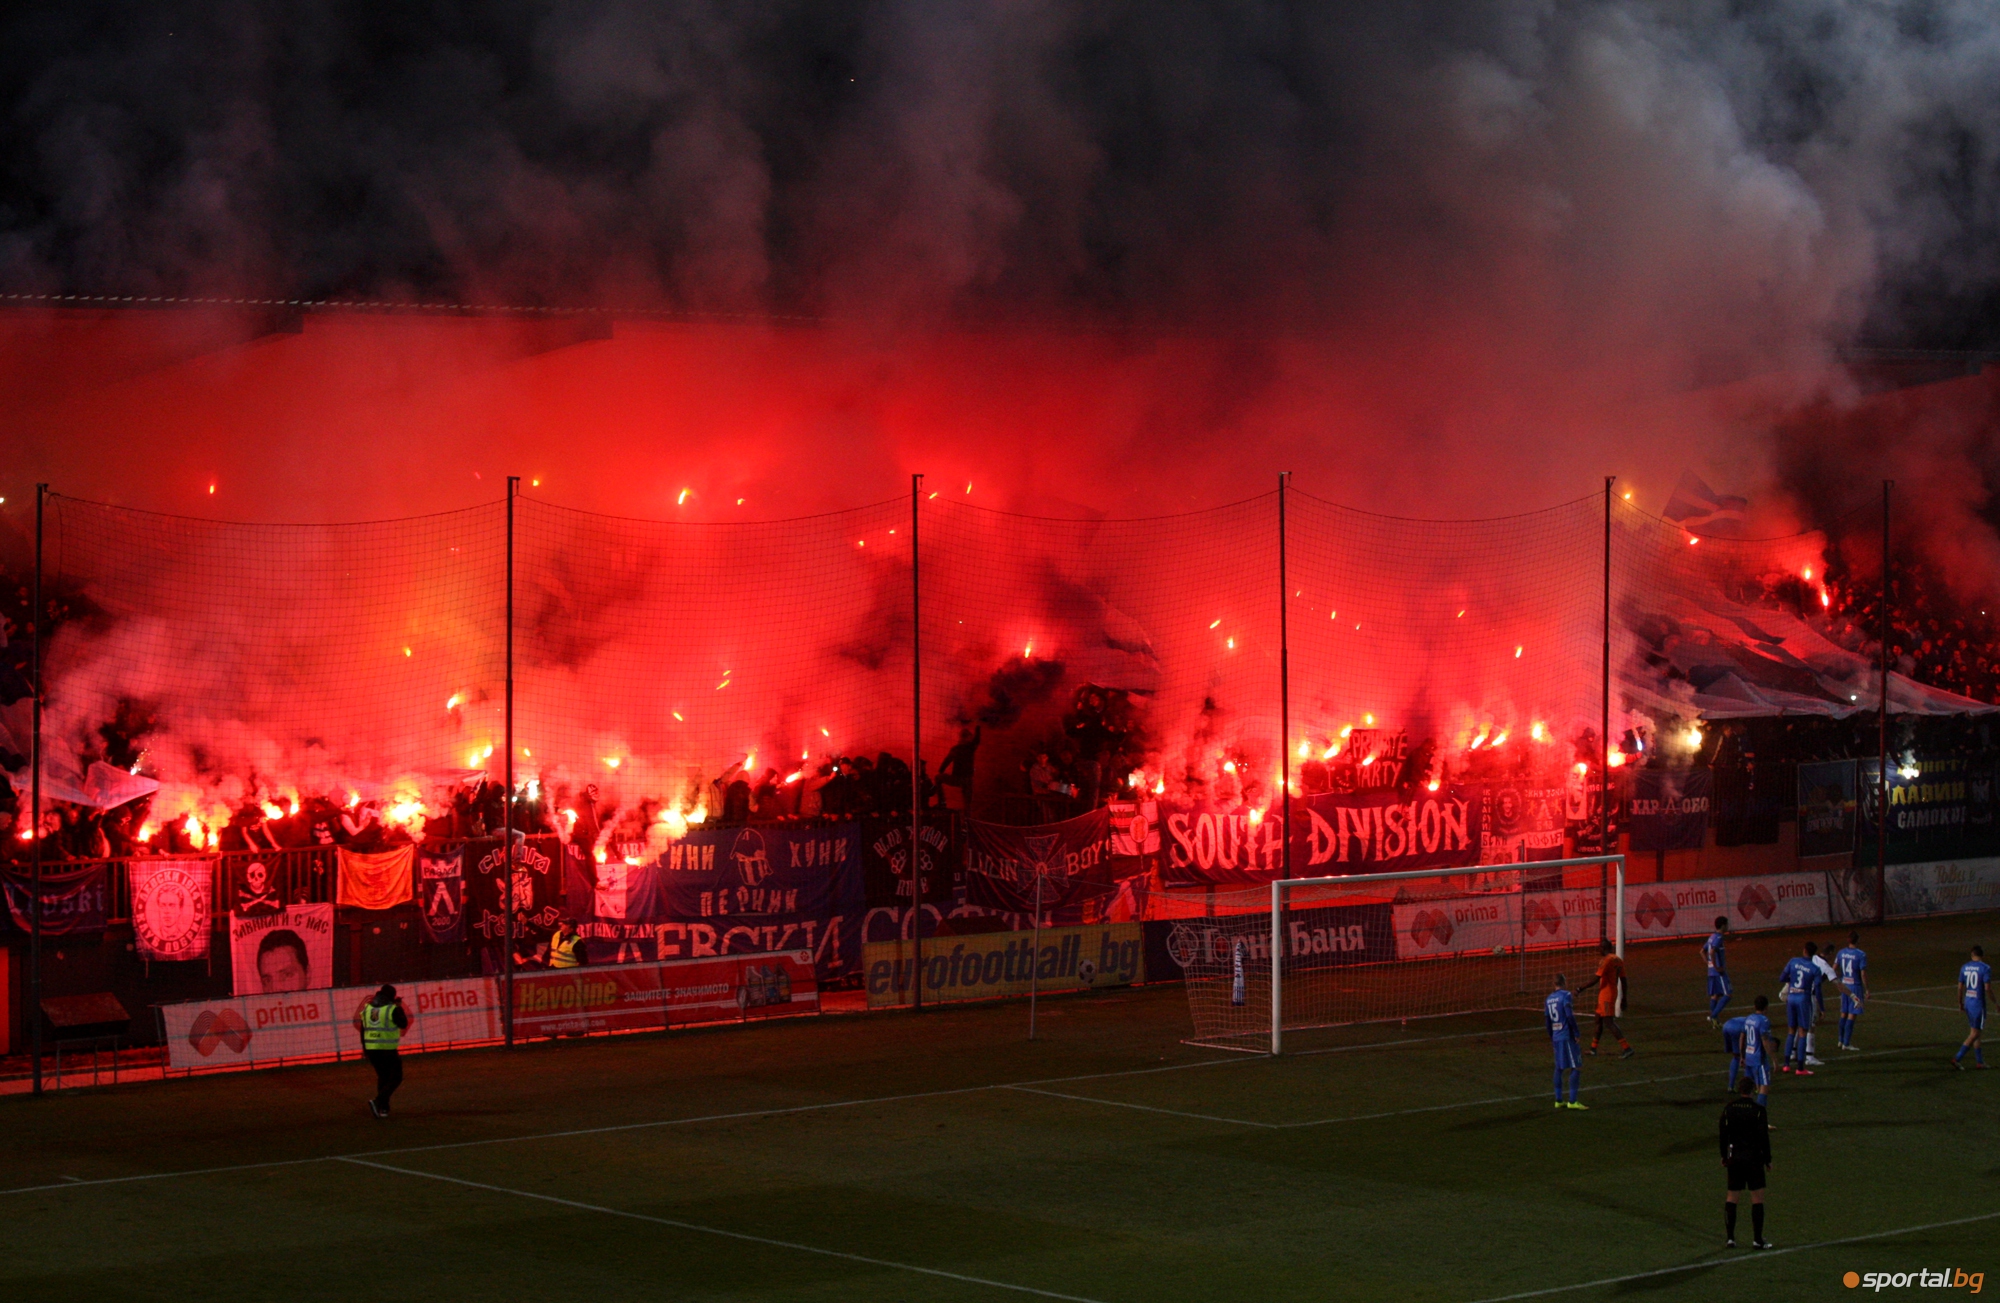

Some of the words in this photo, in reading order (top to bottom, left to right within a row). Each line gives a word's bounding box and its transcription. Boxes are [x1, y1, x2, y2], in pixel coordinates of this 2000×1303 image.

[1355, 760, 1402, 788] PARTY
[1168, 811, 1291, 871] SOUTH
[1305, 797, 1472, 866] DIVISION
[789, 837, 848, 868] ХУНИ
[896, 877, 929, 896] RUE
[1776, 880, 1816, 901] prima
[700, 886, 799, 917] ПЕРНИК
[1676, 888, 1717, 909] prima
[1454, 903, 1499, 926] prima
[232, 912, 290, 942] ЗАВИНАГИ
[306, 916, 330, 934] НАС
[624, 923, 655, 938] TEAM
[1289, 921, 1366, 957] Баня
[1794, 970, 1804, 988] 3
[1842, 958, 1853, 977] 14
[1963, 971, 1979, 989] 70
[417, 987, 479, 1014] prima
[519, 977, 618, 1013] Havoline
[624, 987, 672, 1002] ЗАЩИТЕТЕ
[674, 982, 730, 999] ЗНАЧИМОТО
[255, 1001, 320, 1029] prima
[1547, 1003, 1559, 1022] 15
